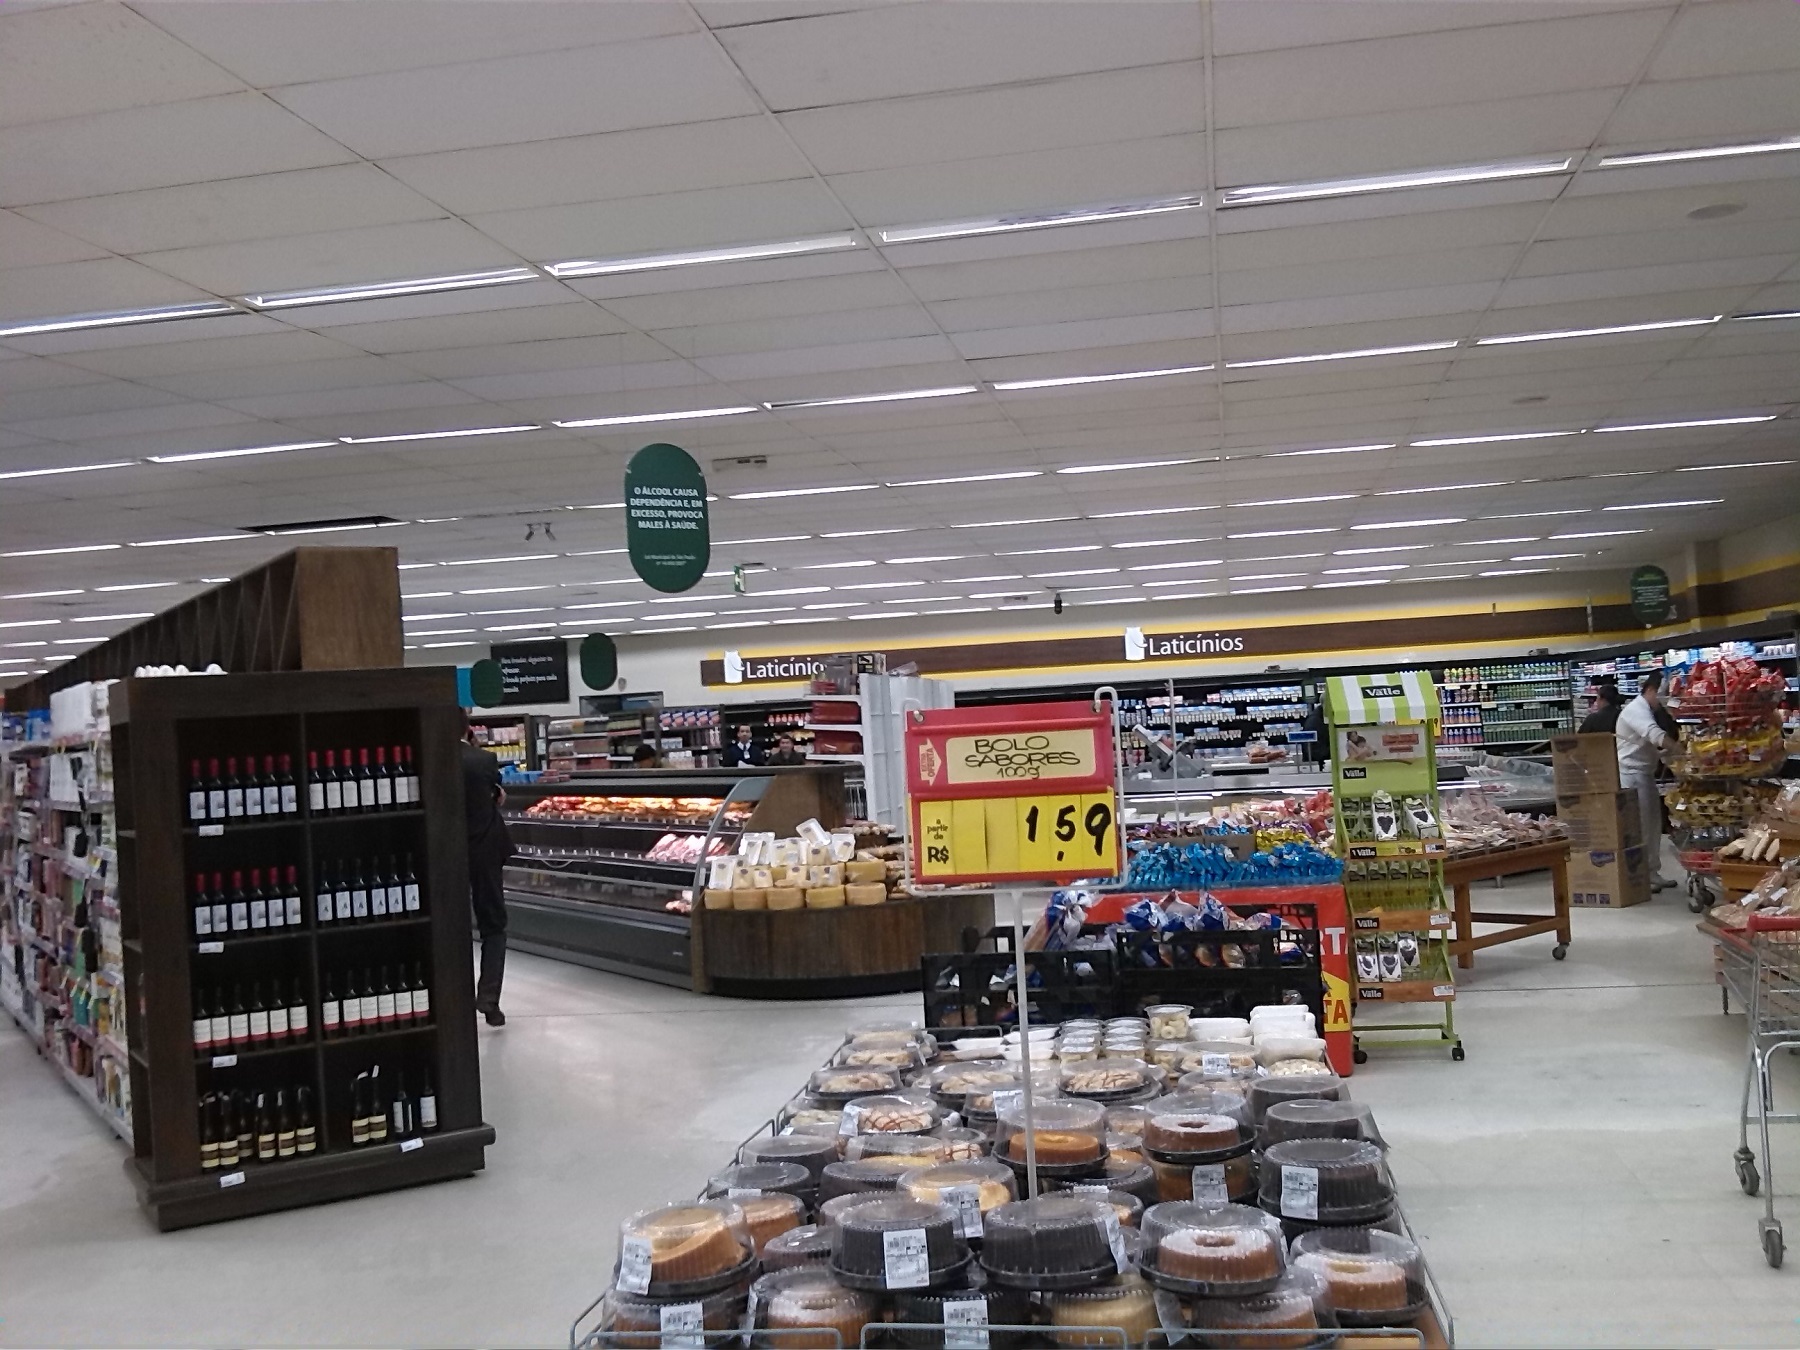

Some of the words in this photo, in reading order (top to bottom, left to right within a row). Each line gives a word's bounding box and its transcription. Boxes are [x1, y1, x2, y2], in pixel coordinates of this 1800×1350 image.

[634, 487, 641, 495] O
[642, 486, 672, 496] ÁLCOOL
[673, 488, 699, 496] CAUSA
[630, 498, 682, 508] DEPENDÊNCIA
[691, 500, 703, 508] EM
[668, 510, 704, 519] PROVOCA
[638, 520, 664, 529] MALES
[1149, 633, 1244, 656] Laticínios
[974, 735, 1050, 754] BOLO
[927, 748, 936, 777] OFERTA
[964, 751, 1081, 768] SABORES
[927, 824, 948, 834] partir
[927, 845, 949, 864] R$
